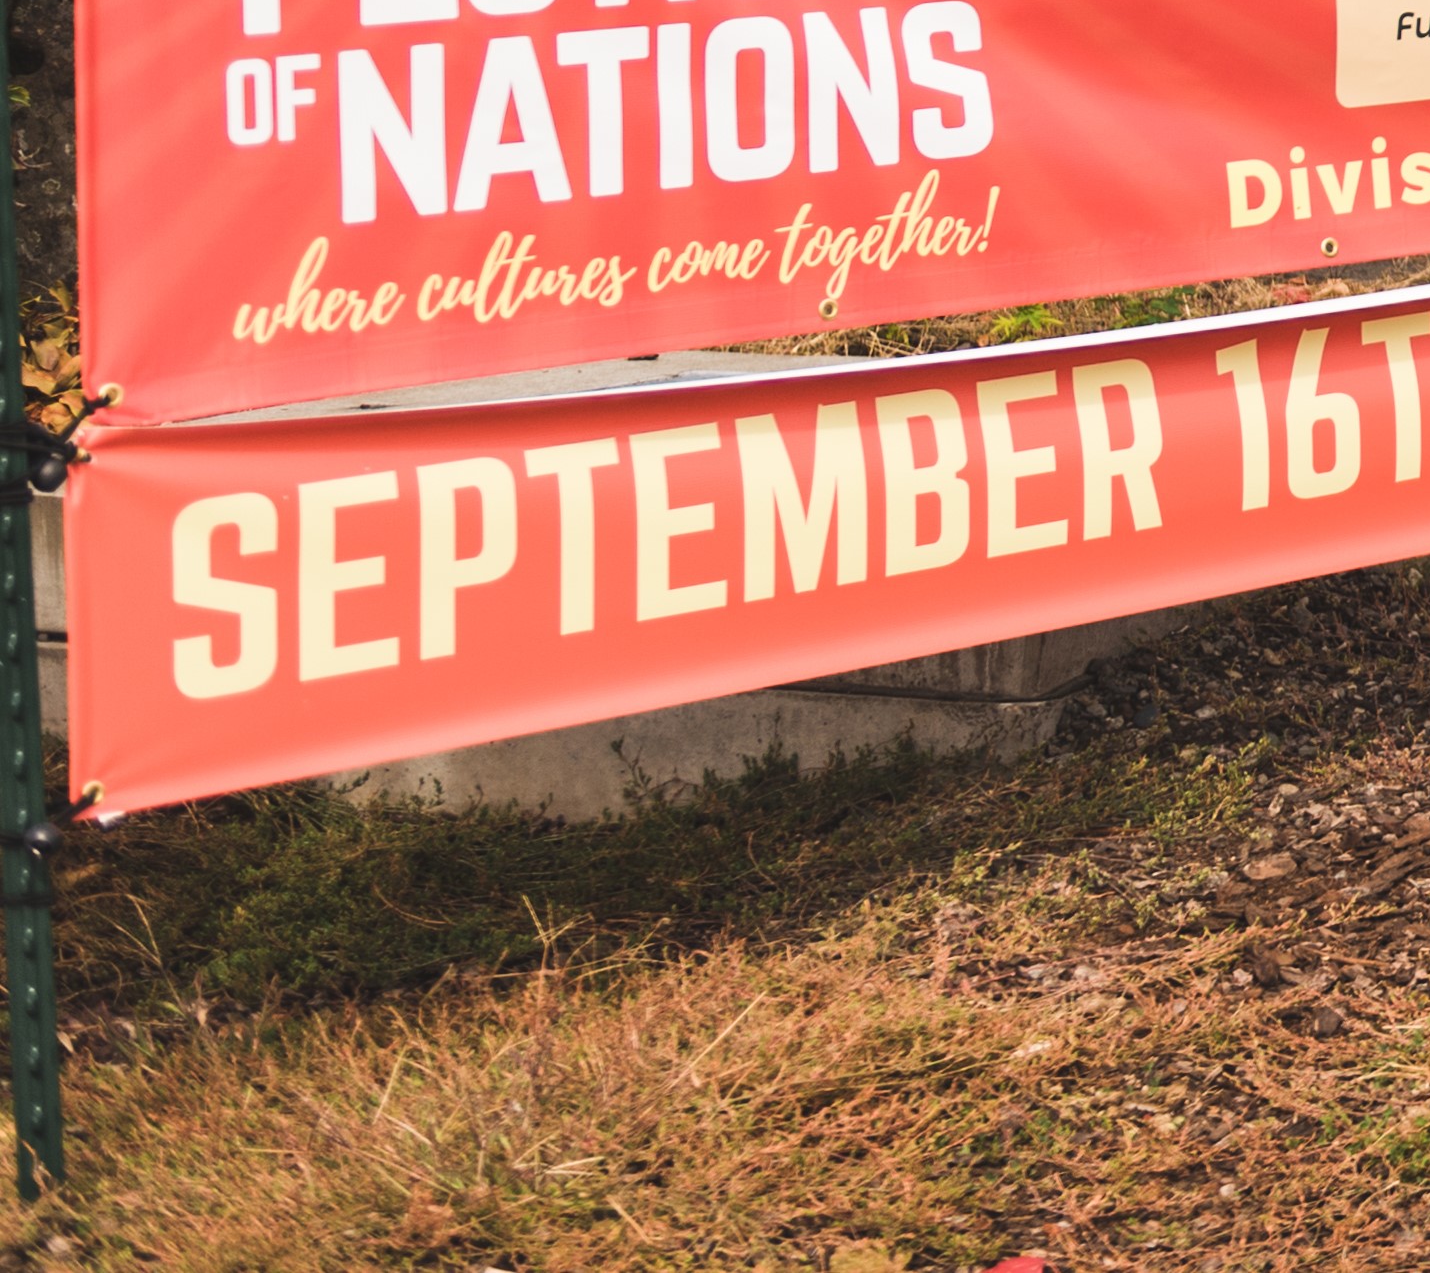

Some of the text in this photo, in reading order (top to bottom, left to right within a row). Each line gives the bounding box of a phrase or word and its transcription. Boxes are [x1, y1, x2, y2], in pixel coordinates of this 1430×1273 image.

[226, 0, 994, 225] OF NATIONS
[232, 168, 1001, 344] where cultures come together!
[168, 354, 1166, 704] SEPTEMBER
